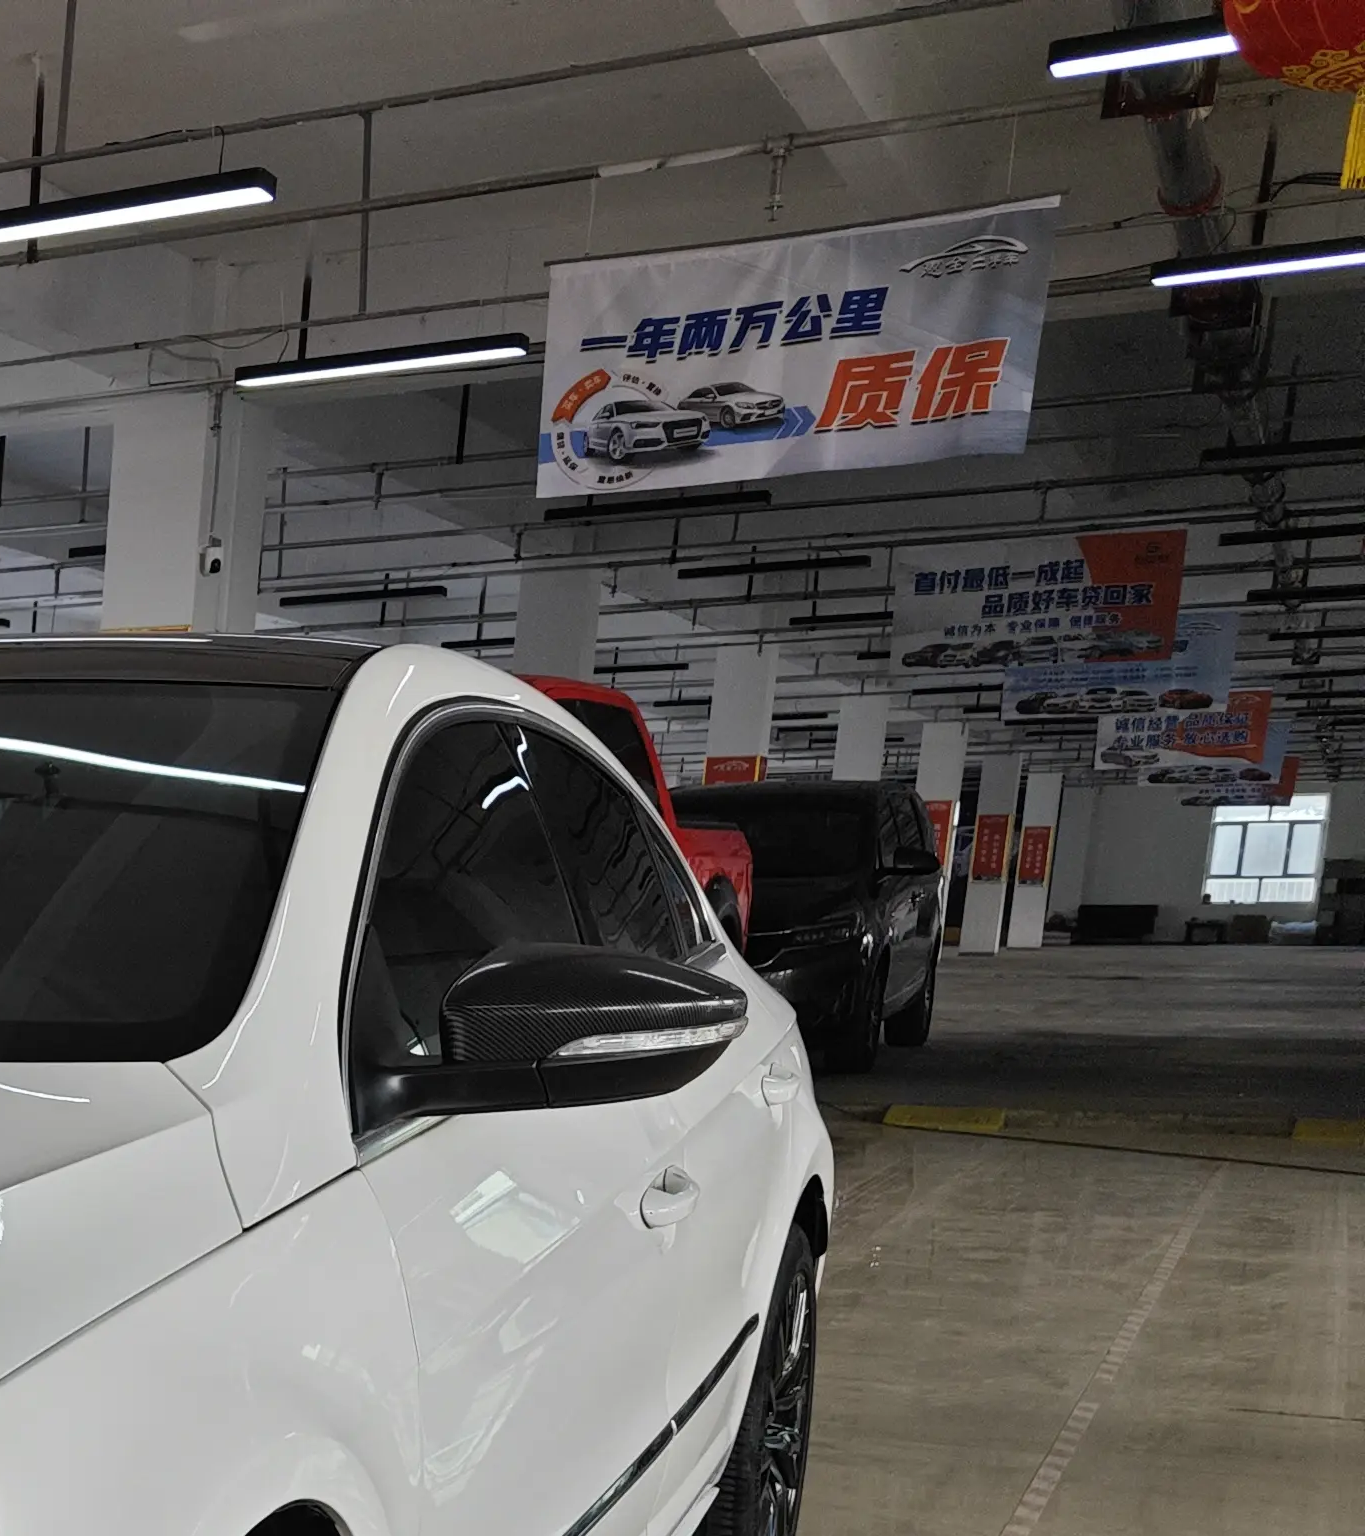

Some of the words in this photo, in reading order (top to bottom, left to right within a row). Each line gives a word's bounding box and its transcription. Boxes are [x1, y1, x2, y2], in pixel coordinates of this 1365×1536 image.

[580, 286, 889, 361] 一年两万公里
[814, 337, 1011, 434] 质保
[914, 558, 1085, 596] 首付最低一成起
[981, 583, 1154, 619] 品质好车贷回家
